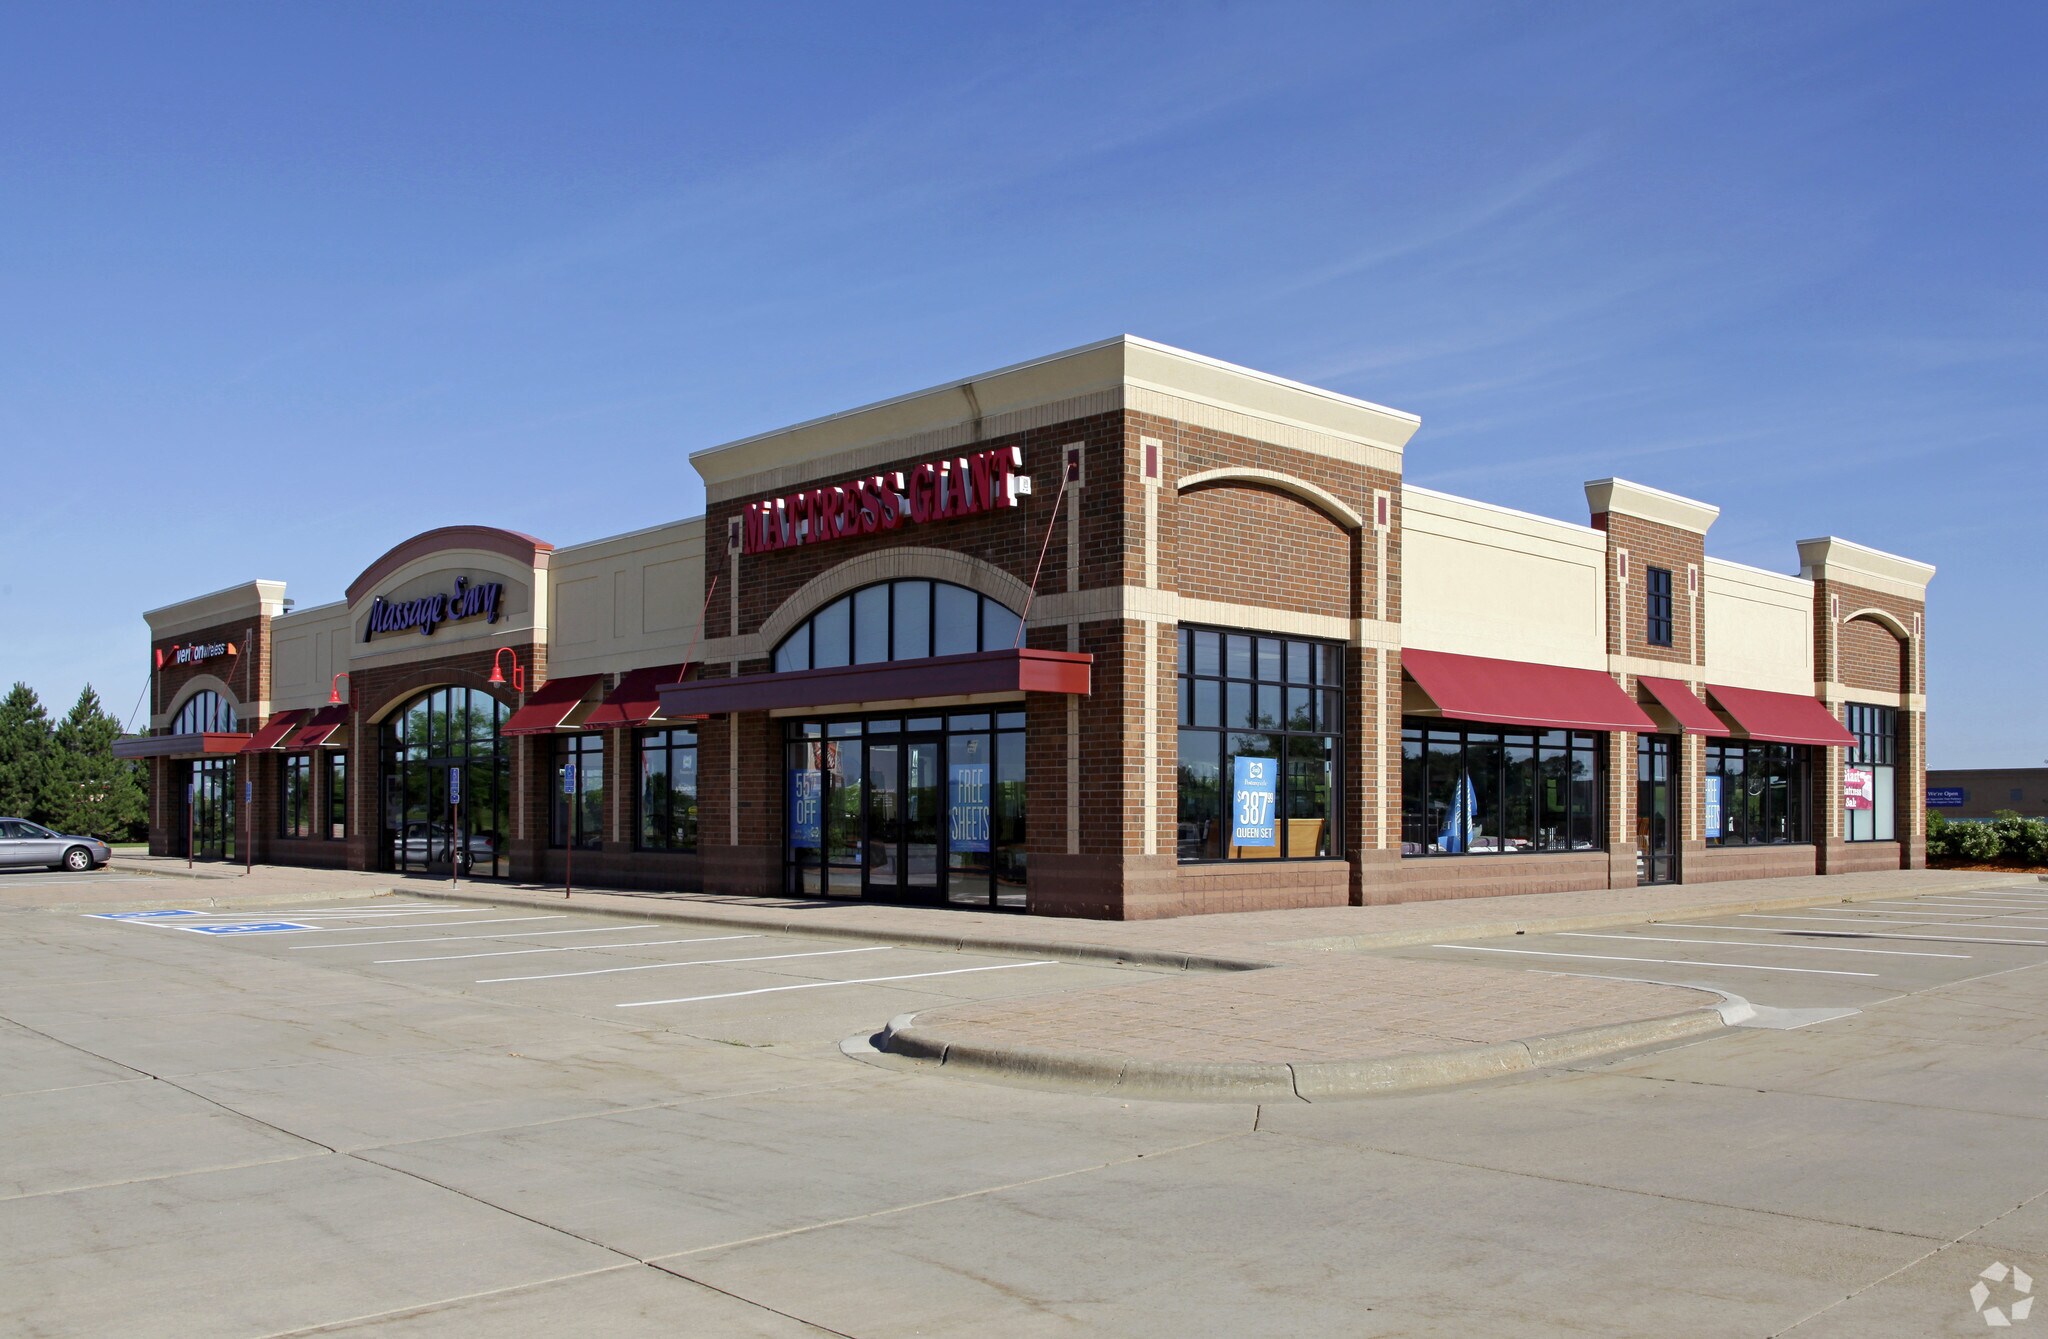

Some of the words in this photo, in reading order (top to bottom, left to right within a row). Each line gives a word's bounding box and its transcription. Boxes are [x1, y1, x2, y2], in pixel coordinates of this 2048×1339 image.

[743, 471, 905, 554] MATTRESS
[909, 446, 1022, 524] GIANT
[363, 595, 447, 643] Massage
[447, 575, 502, 625] Envy
[176, 643, 204, 665] verizon
[203, 642, 226, 659] wireless
[958, 768, 983, 803] FREE
[1943, 790, 1959, 798] Open
[796, 800, 817, 825] OFF
[951, 806, 990, 841] SHEETS
[1236, 827, 1259, 838] QUEEN
[1260, 828, 1273, 839] SET
